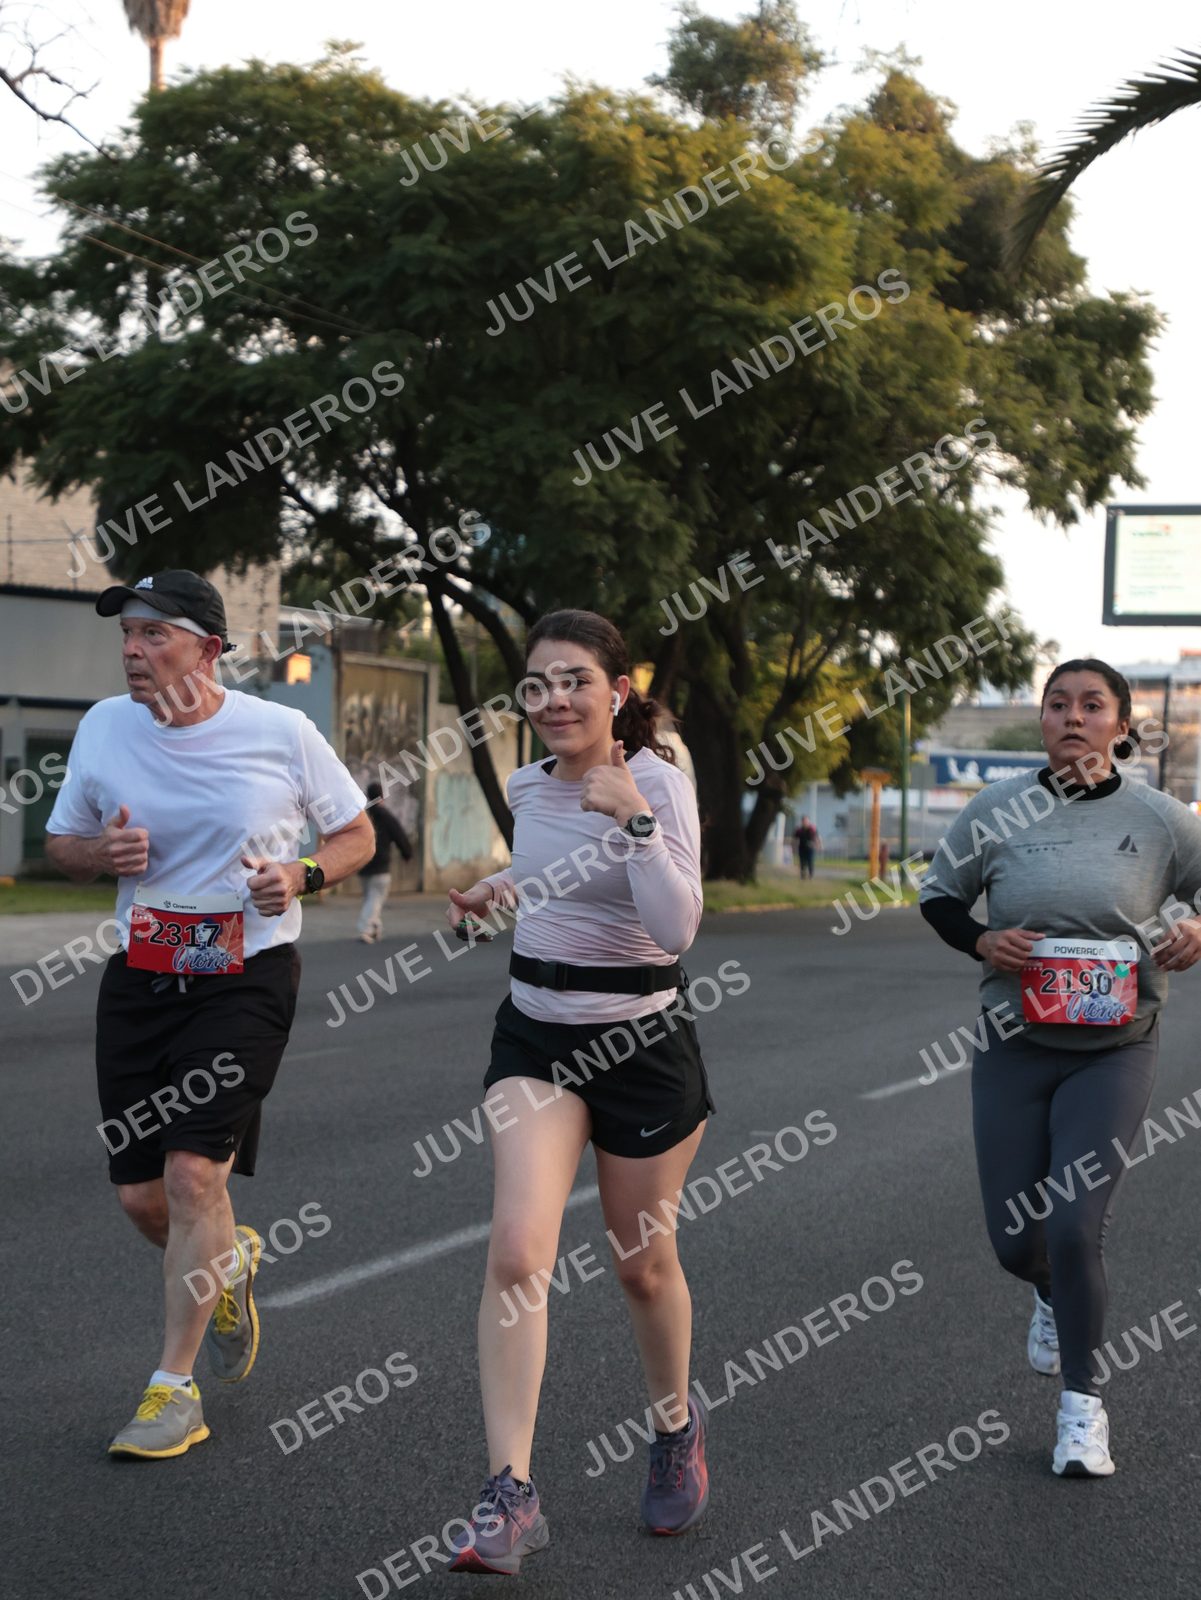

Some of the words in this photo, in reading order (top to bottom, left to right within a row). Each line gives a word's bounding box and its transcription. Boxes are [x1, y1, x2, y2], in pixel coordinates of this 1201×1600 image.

[148, 919, 220, 948] 2317
[1053, 945, 1105, 957] POWERADE
[1040, 967, 1113, 996] 2190
